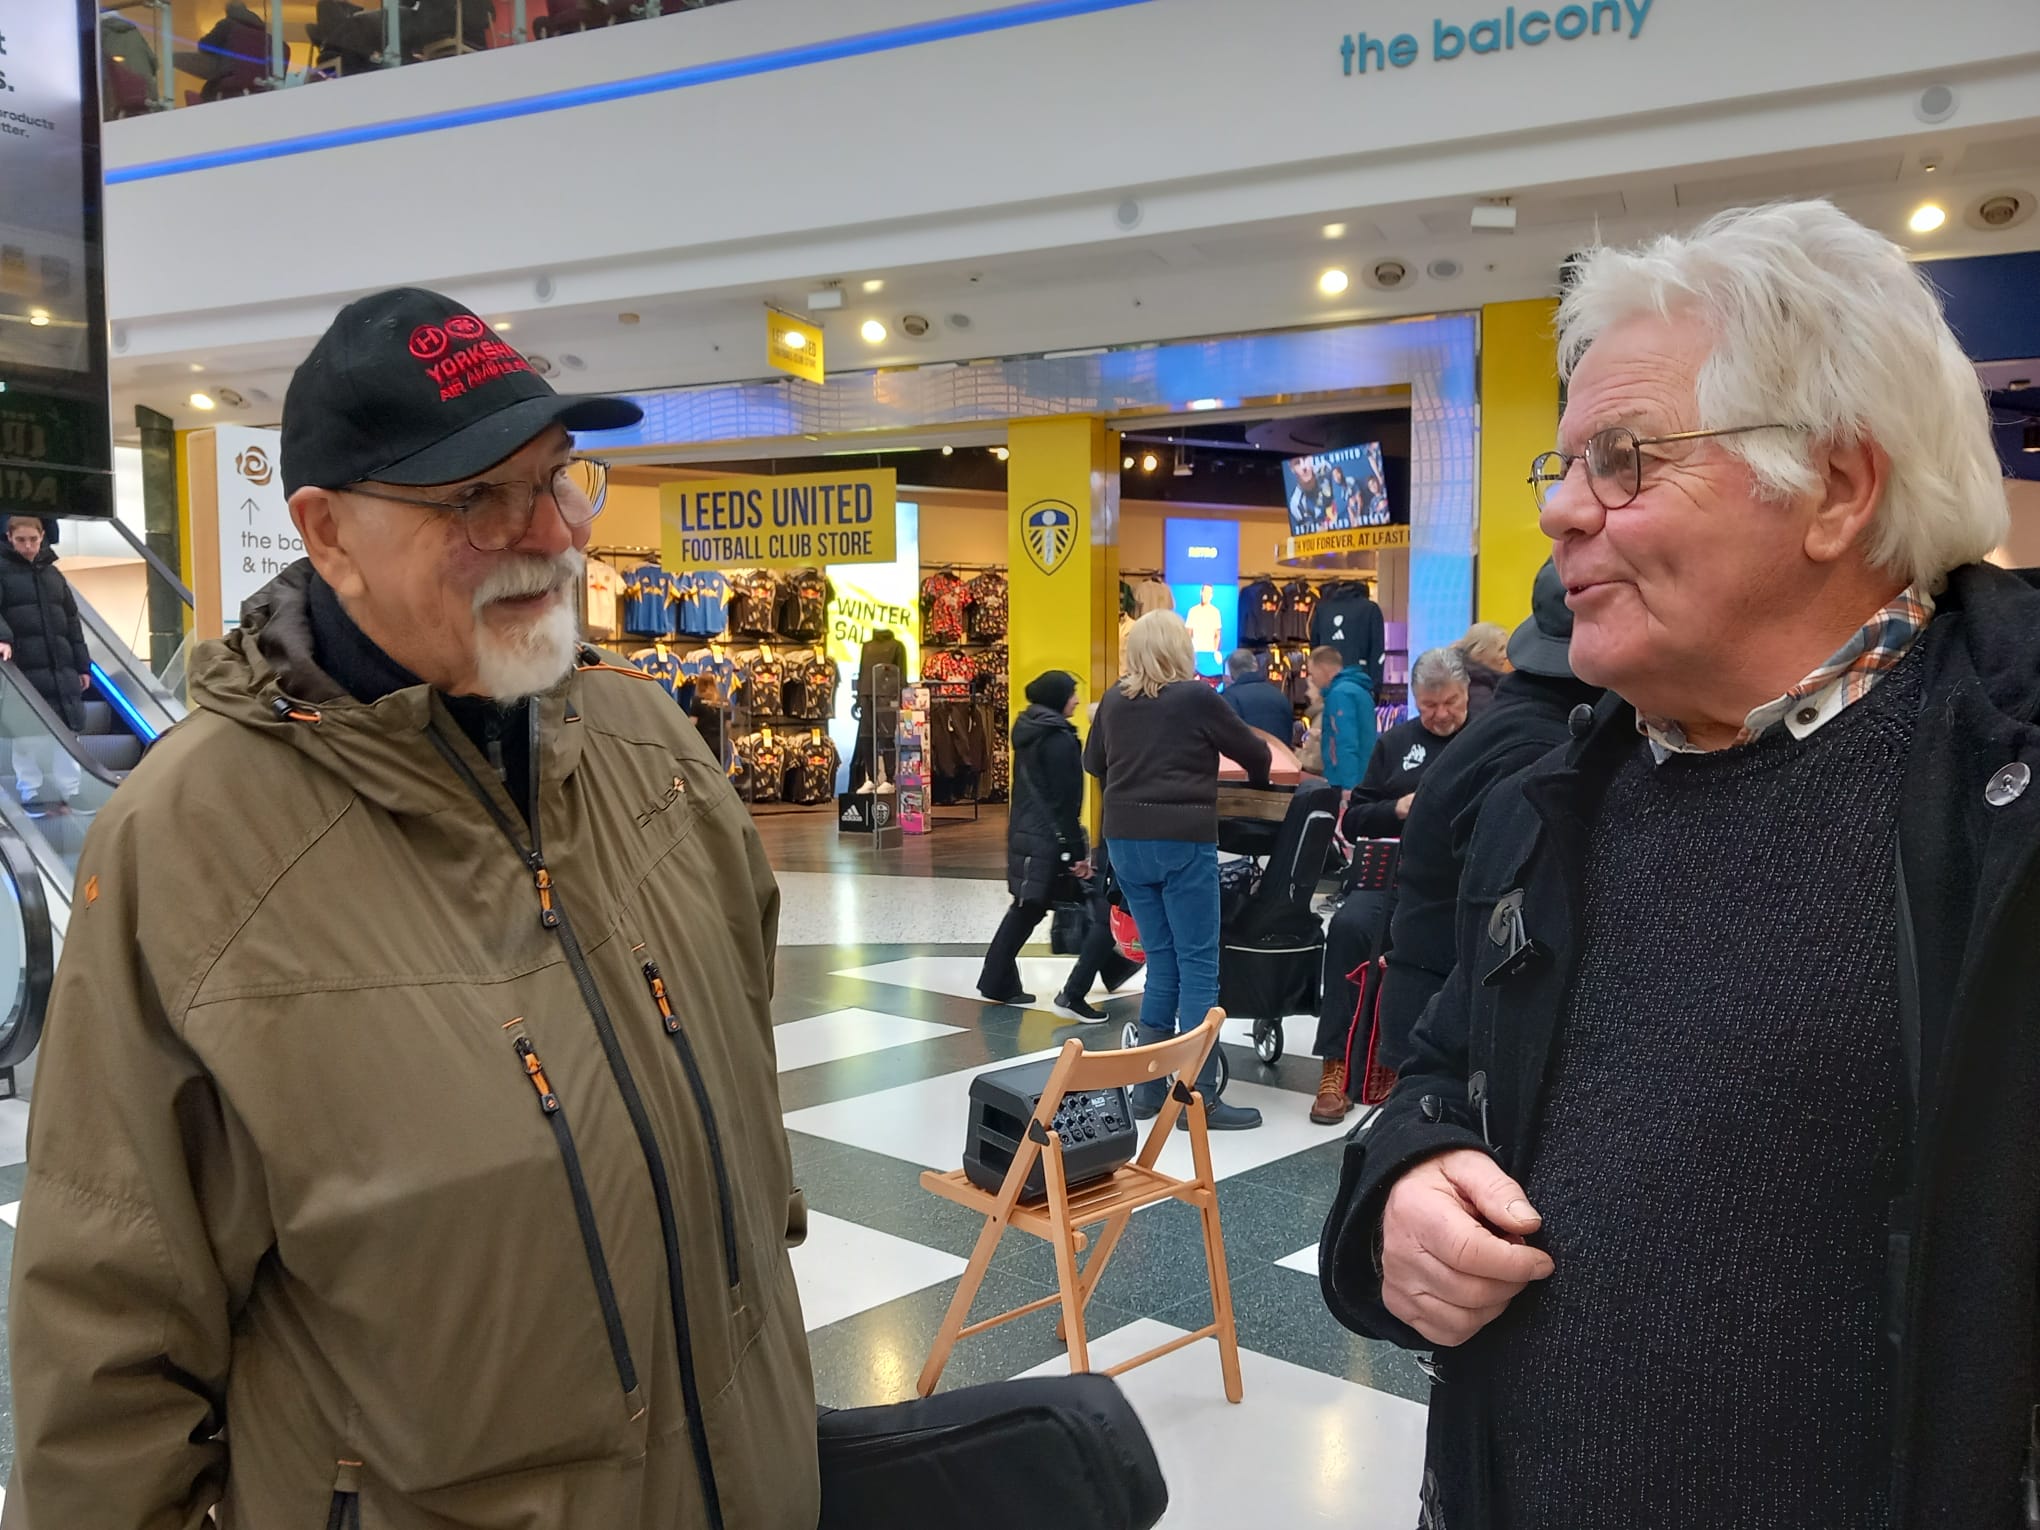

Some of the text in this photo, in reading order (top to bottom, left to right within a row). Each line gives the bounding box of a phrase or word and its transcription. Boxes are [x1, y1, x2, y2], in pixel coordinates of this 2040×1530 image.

[1340, 0, 1651, 76] the balcony
[0, 121, 30, 139] tter.
[439, 378, 467, 402] AIR
[680, 483, 873, 532] LEEDS UNITED
[241, 531, 304, 551] the ba
[682, 530, 873, 562] FOOTBALL CLUB STORE
[1358, 533, 1370, 546] AT
[242, 556, 256, 573] &
[837, 597, 911, 627] WINTER
[835, 620, 864, 645] SAL
